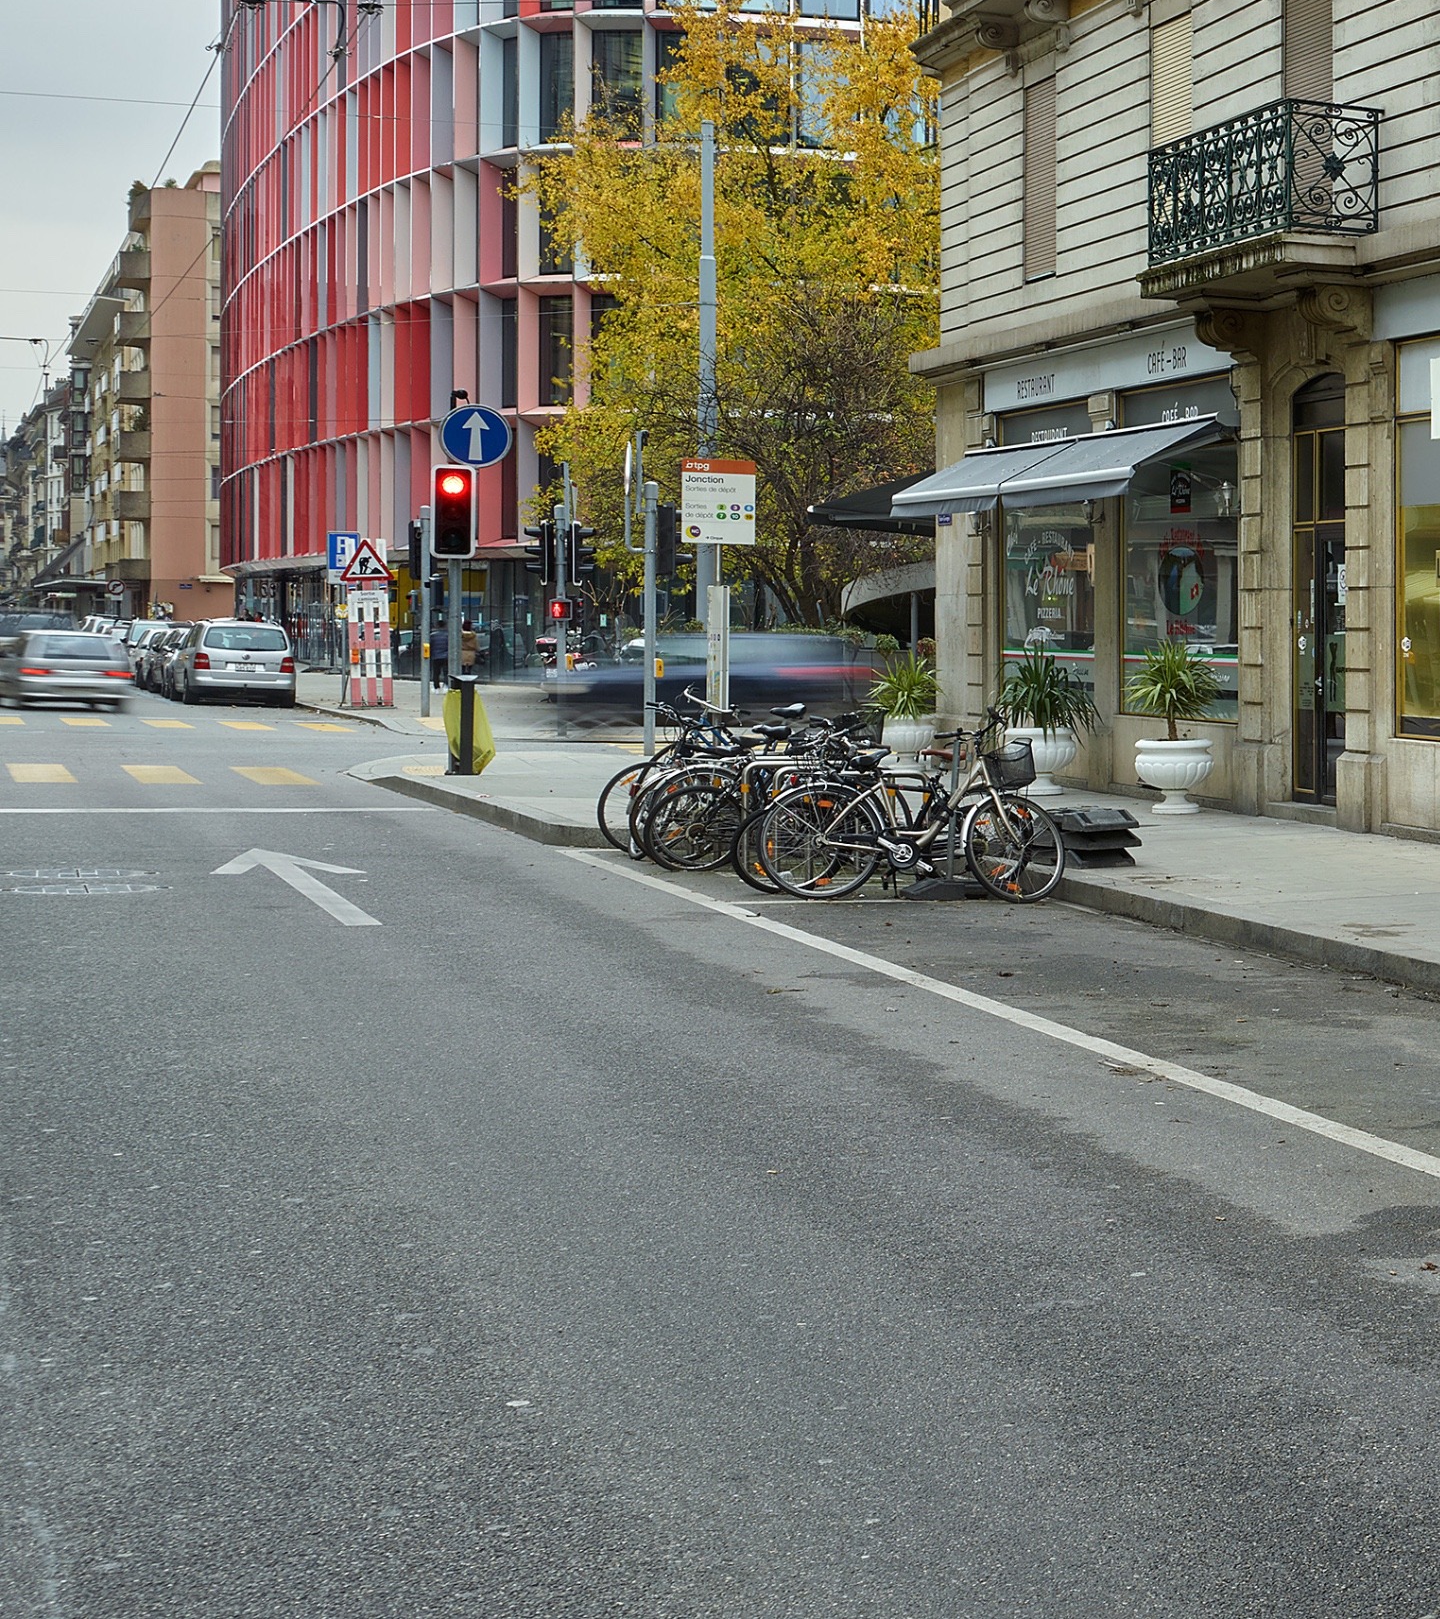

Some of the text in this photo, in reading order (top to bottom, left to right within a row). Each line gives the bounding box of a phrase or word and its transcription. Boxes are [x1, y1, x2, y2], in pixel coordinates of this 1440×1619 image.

[1017, 374, 1055, 400] RESTAURANT
[694, 462, 710, 472] tpg
[685, 475, 724, 484] Jonction
[685, 502, 707, 510] Sorties
[1025, 565, 1075, 601] Le Rhône
[1037, 607, 1062, 619] PIZZERIA
